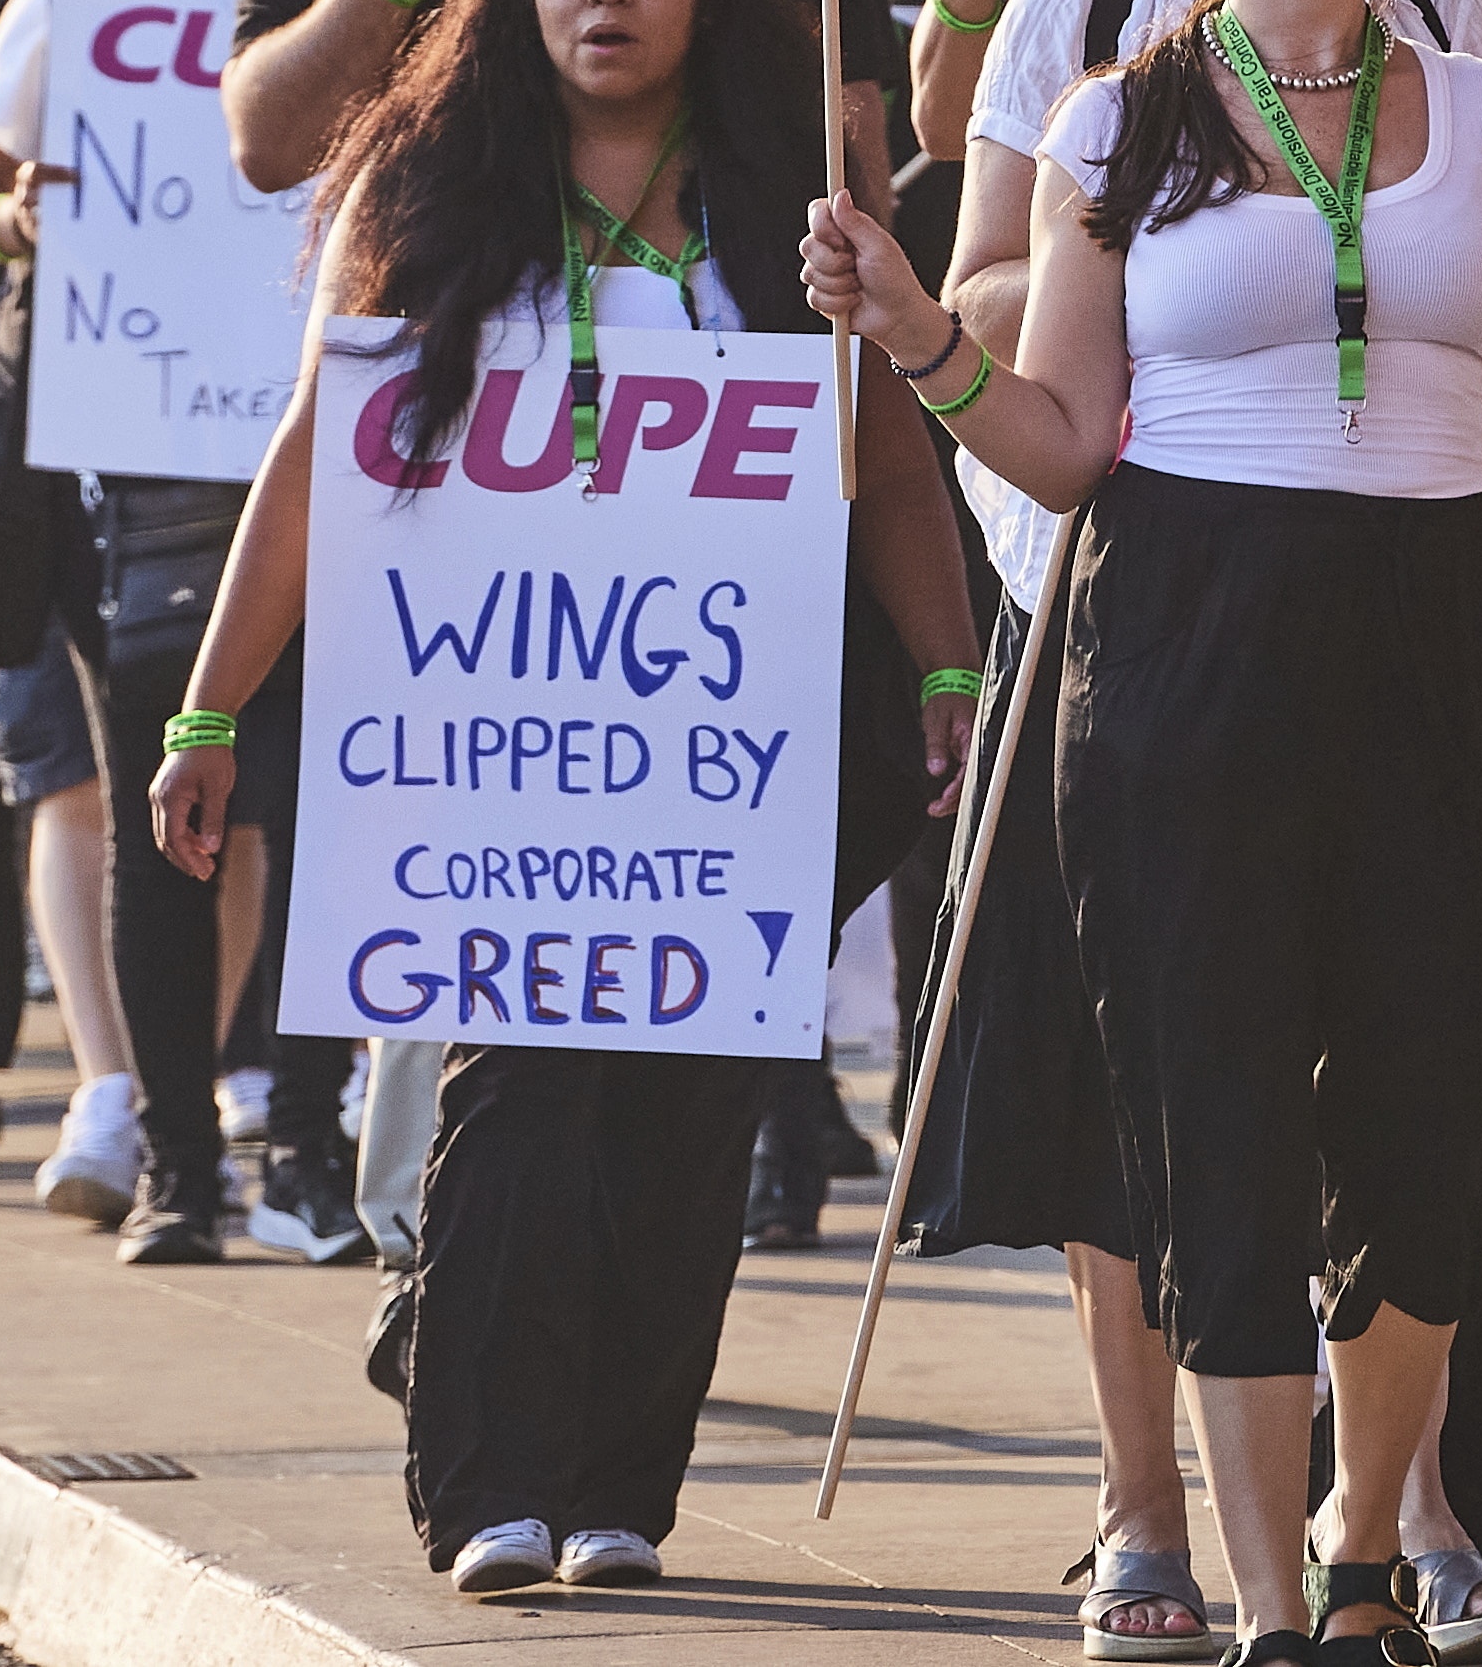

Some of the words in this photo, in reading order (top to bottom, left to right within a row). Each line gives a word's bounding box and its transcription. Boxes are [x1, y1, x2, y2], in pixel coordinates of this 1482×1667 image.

[89, 6, 225, 89] CU
[1221, 15, 1259, 77] Contract
[1251, 77, 1278, 111] Fair
[70, 108, 194, 227] No
[1315, 185, 1347, 220] More
[1337, 221, 1357, 249] No
[64, 271, 162, 343] No
[352, 369, 821, 501] CUPE
[386, 568, 747, 701] WINGS
[338, 715, 652, 796] CLIPPED
[688, 724, 789, 809] BY
[394, 844, 736, 902] CORPORATE
